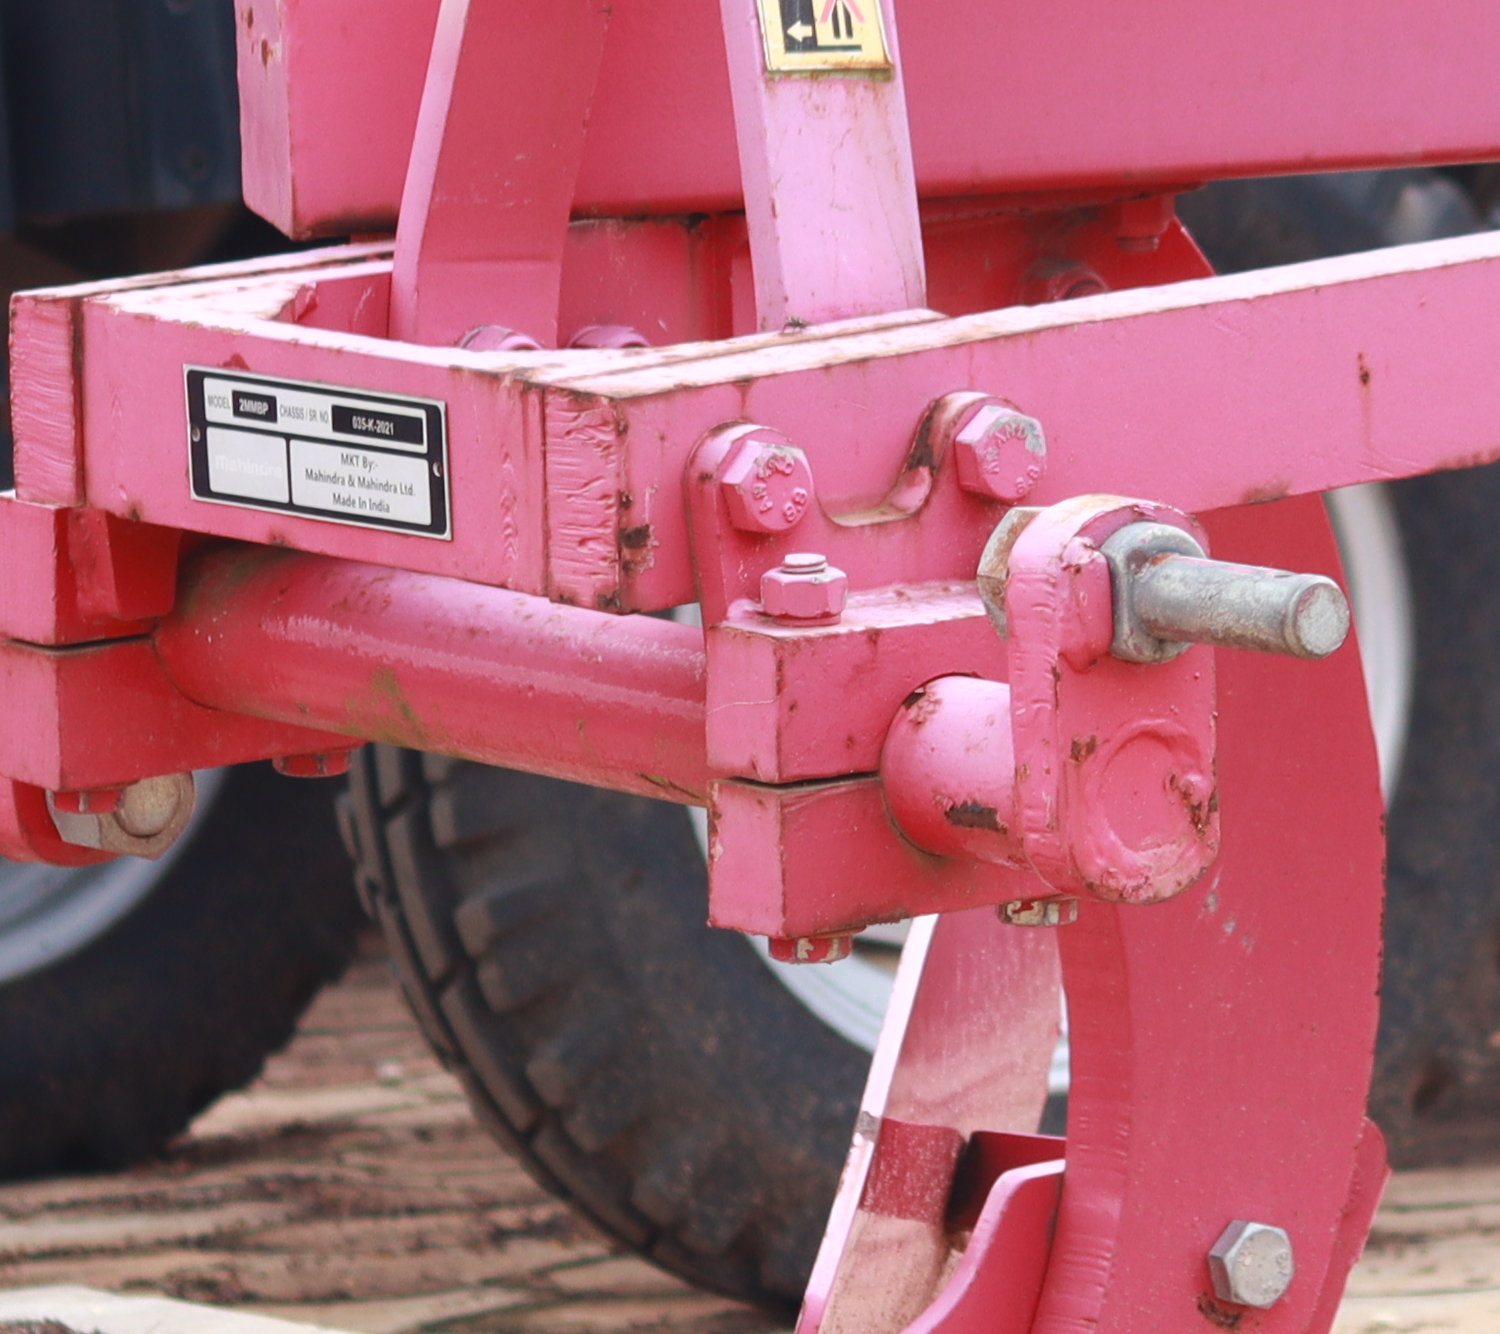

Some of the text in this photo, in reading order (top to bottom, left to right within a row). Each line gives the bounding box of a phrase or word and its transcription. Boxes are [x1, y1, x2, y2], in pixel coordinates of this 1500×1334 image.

[206, 393, 231, 411] MODEL
[279, 403, 304, 422] CHASSIS
[340, 452, 360, 468] MKT
[305, 467, 416, 497] Mahindra & Mahindra Ltd.
[332, 492, 390, 513] Made In India
